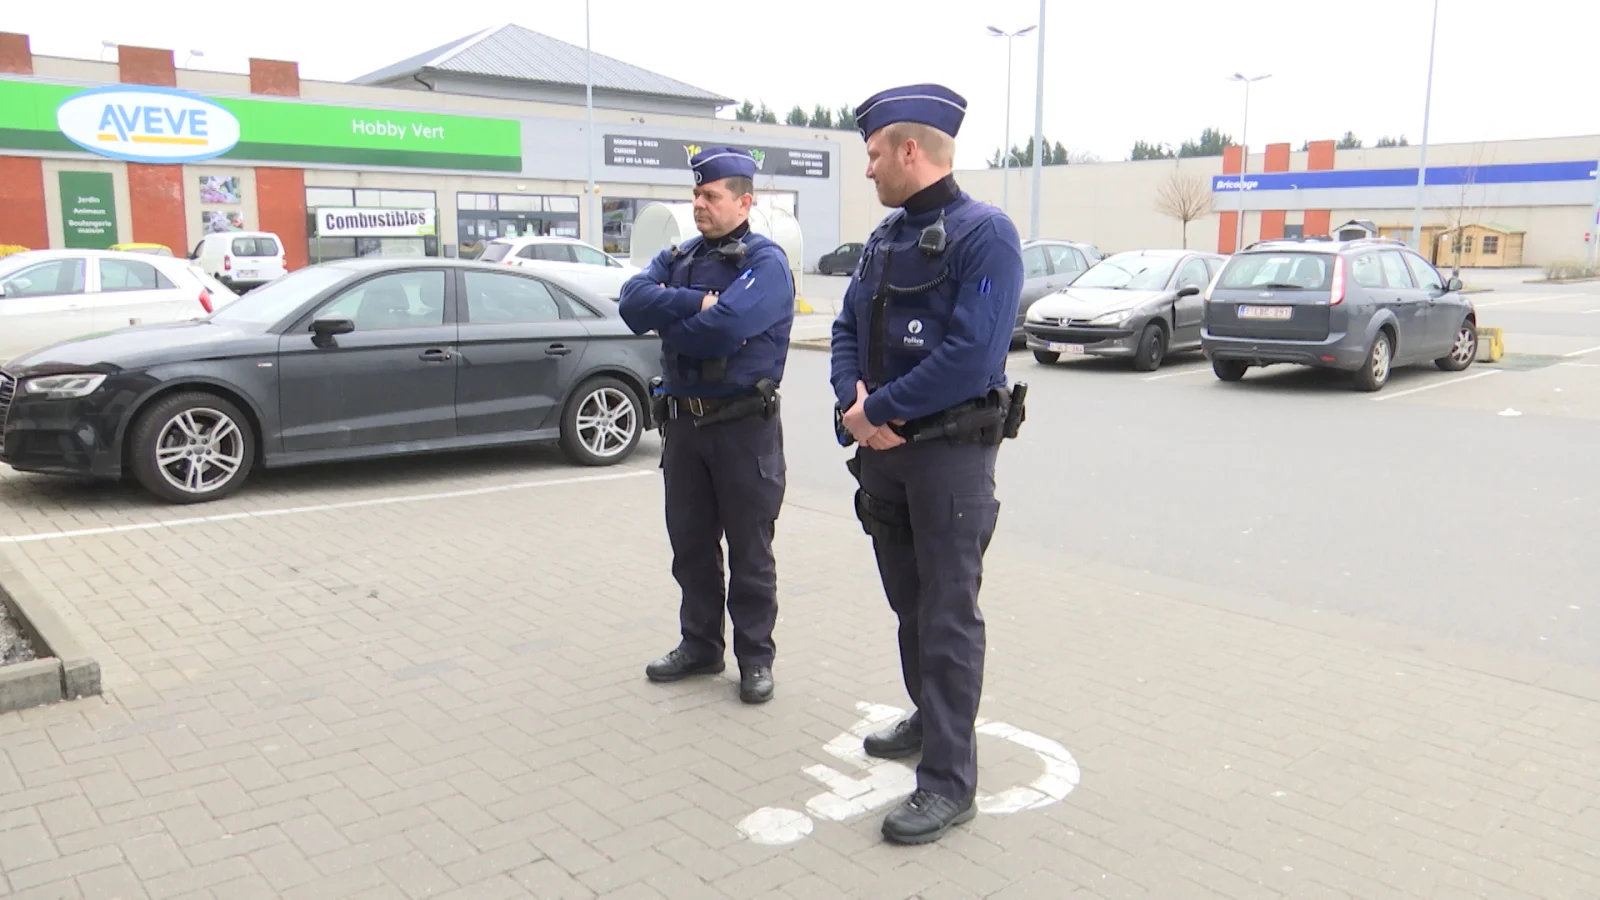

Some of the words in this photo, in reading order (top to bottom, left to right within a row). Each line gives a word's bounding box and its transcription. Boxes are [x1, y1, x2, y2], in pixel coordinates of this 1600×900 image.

[98, 104, 208, 142] AVEVE
[352, 119, 406, 139] Hobby
[412, 123, 444, 139] Vert
[613, 147, 636, 155] CUISINE
[613, 156, 625, 164] ART
[643, 158, 660, 166] TABLE
[77, 196, 101, 204] Jardin
[73, 207, 106, 215] Animaux
[68, 219, 112, 228] Boulangerie
[326, 210, 426, 231] Combustibles
[903, 336, 924, 345] Police
